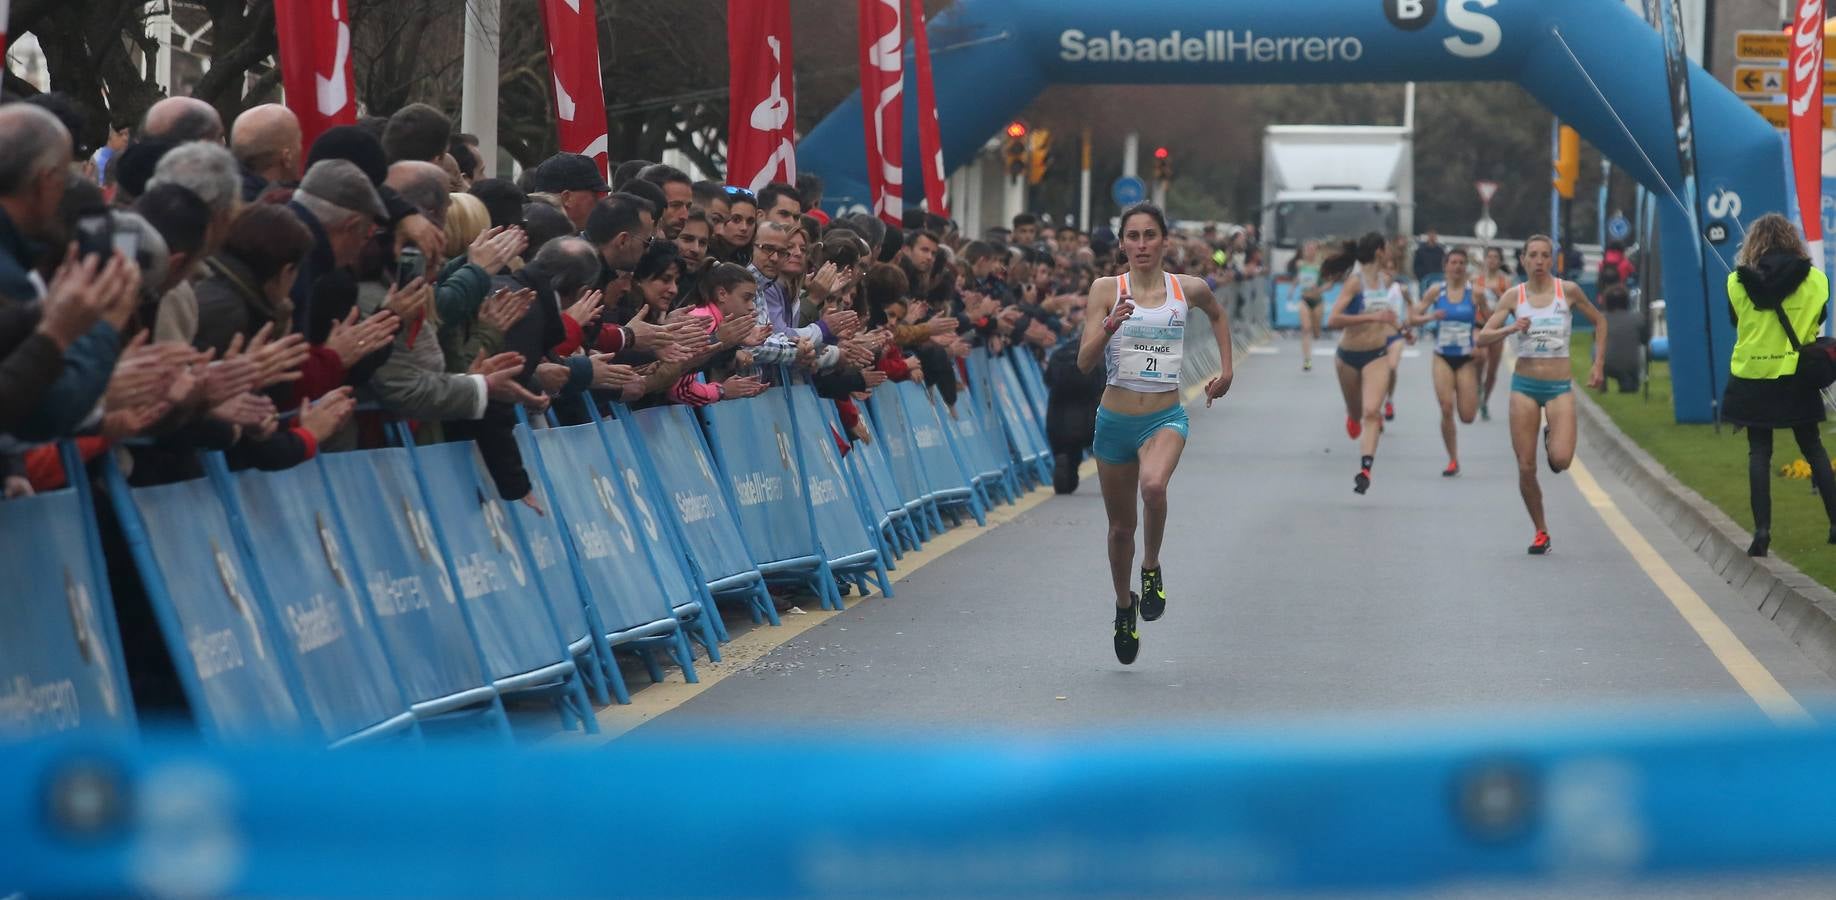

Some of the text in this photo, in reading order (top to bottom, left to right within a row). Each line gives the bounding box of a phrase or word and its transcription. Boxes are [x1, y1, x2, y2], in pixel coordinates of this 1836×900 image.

[1060, 29, 1363, 62] SabadellHerrero
[1134, 344, 1171, 353] SOLANGE
[1146, 357, 1157, 371] 21
